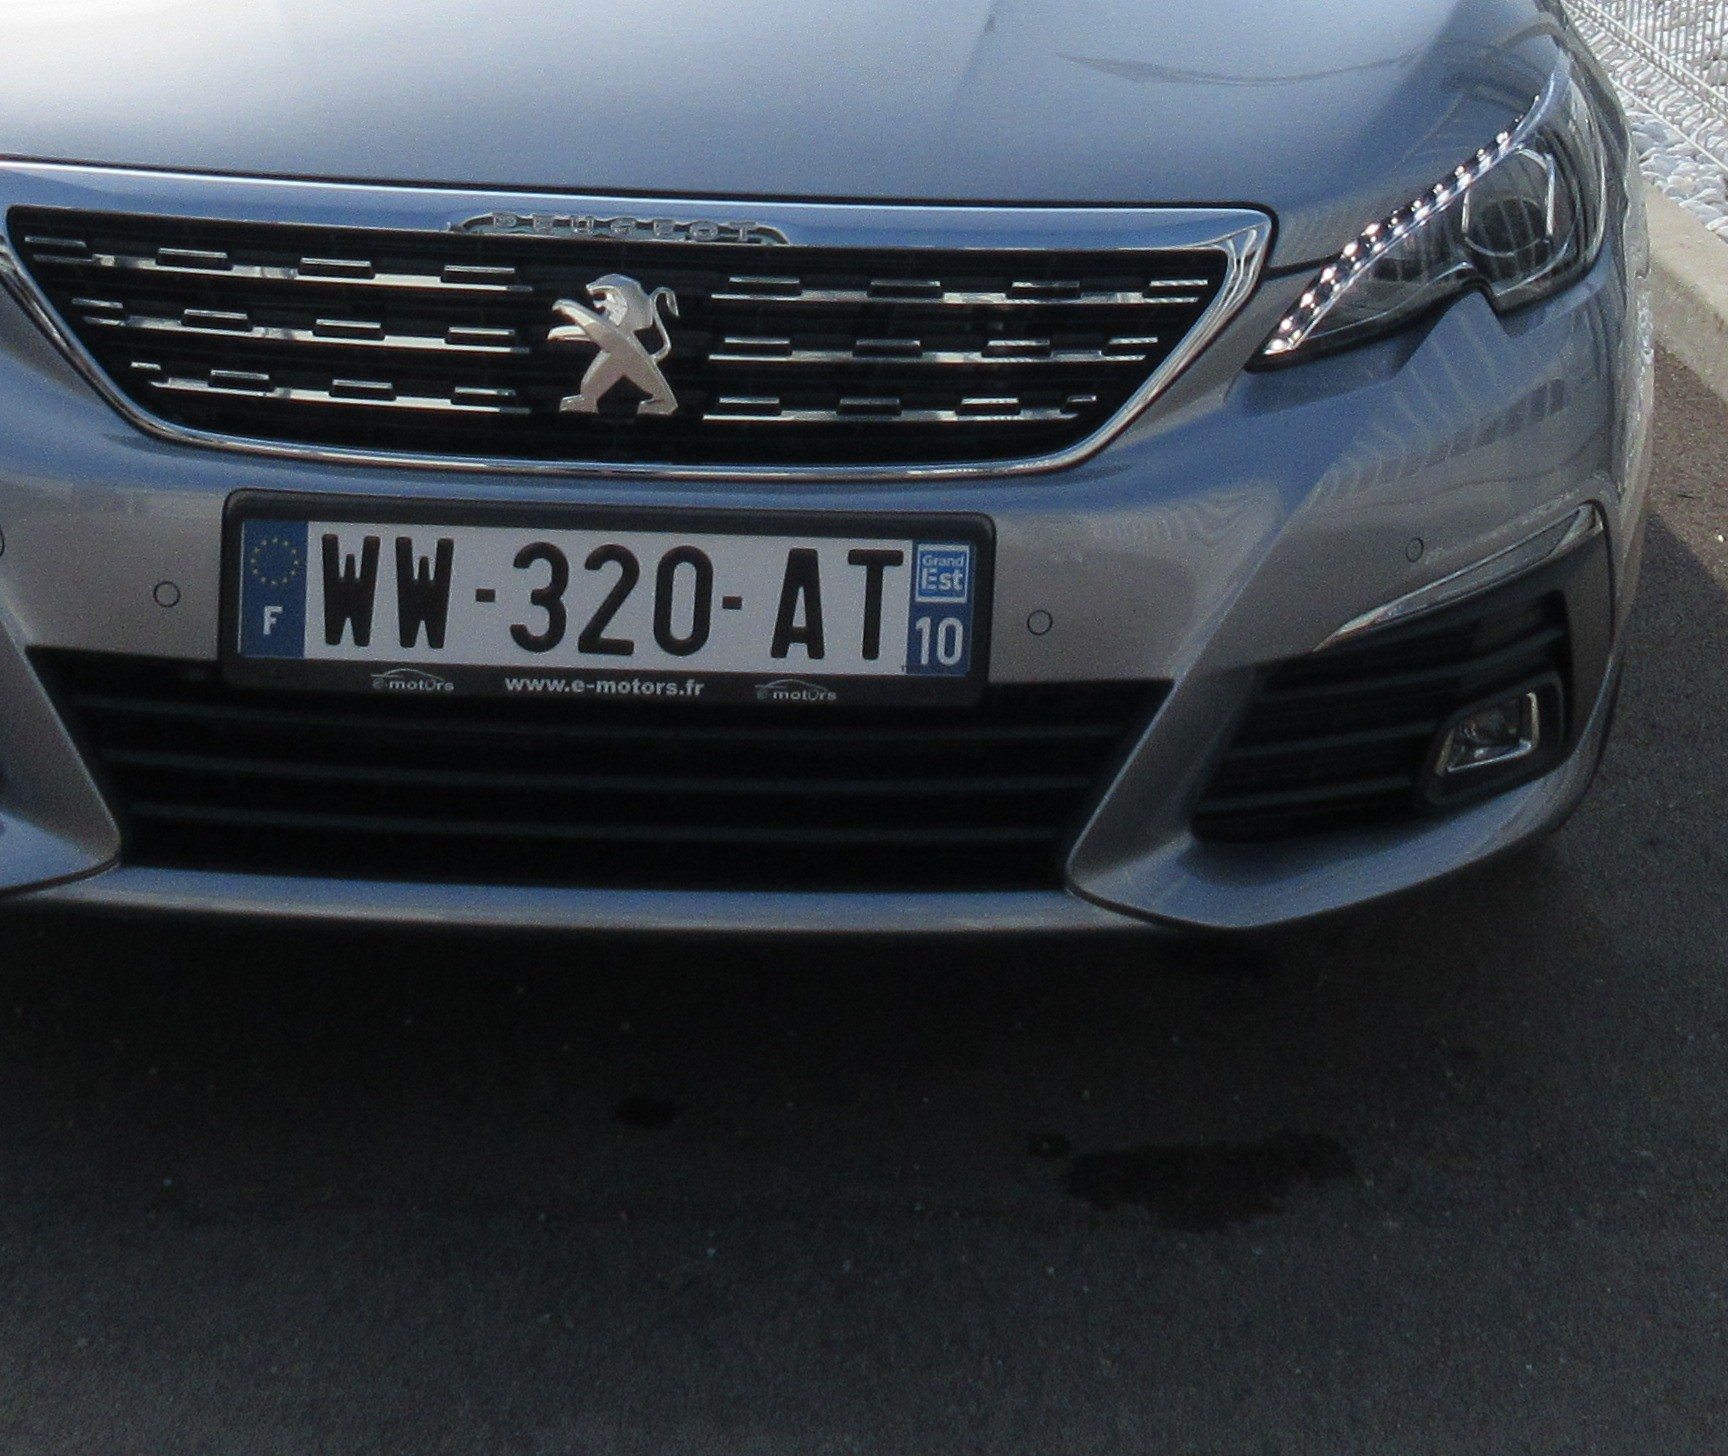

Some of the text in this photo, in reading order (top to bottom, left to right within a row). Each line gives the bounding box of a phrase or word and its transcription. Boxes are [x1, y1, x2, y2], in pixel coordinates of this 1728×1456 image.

[492, 211, 759, 242] PEUGEOT
[922, 554, 965, 567] Grand
[920, 567, 964, 592] Est
[320, 532, 904, 661] WW-320-AT
[262, 605, 284, 636] F
[915, 616, 964, 667] 10
[504, 676, 706, 697] www.e-motors.fr
